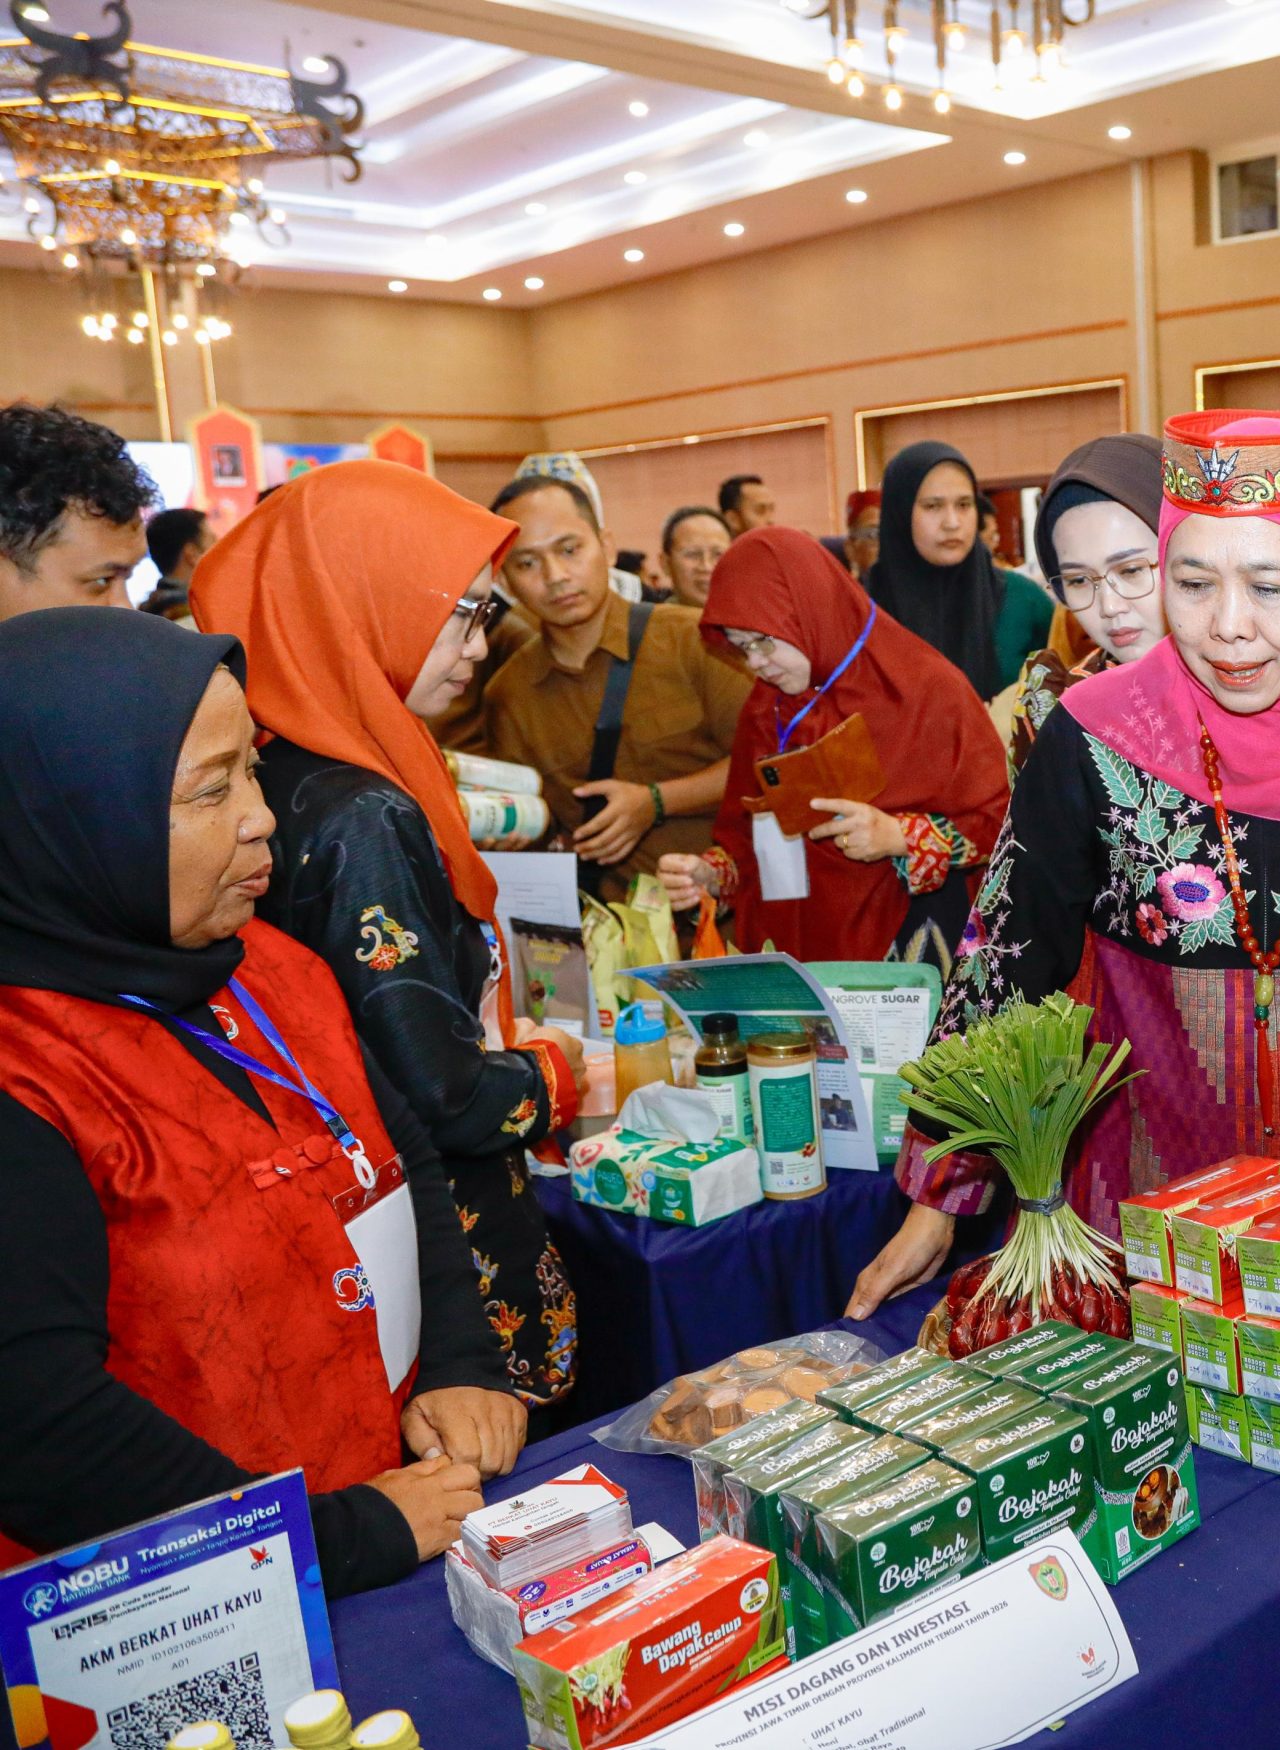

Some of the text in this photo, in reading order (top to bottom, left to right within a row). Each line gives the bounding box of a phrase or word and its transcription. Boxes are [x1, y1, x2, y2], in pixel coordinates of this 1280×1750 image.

[832, 995, 920, 1004] NGROVE SUGAR
[1036, 1341, 1101, 1375] Bajakah
[1083, 1353, 1146, 1391] Bajakah
[1111, 1401, 1178, 1453] Bajakah
[999, 1467, 1082, 1523] Bajakah
[137, 1500, 282, 1562] Transaksi Digital
[140, 1558, 172, 1575] Nyaman
[250, 1557, 274, 1570] GPN
[612, 1543, 635, 1560] HEMAT
[879, 1533, 969, 1593] Bajakah
[57, 1556, 130, 1596] NOBU
[62, 1573, 131, 1604] NATIONAL BANK
[111, 1585, 190, 1620] Pembayaran Nasional
[122, 1597, 142, 1609] Code
[52, 1609, 109, 1640] QRIS
[80, 1588, 263, 1673] AKM BERKAT UHAT KAYU
[640, 1620, 702, 1665] Bawang
[659, 1636, 706, 1674] Dayak
[117, 1659, 144, 1676] NMID
[171, 1657, 190, 1671] A01
[715, 1600, 1009, 1749] PROVINSI JAWA TIMUR DENGAN PROVINSI KALIMANTAN TENGAH TAHUN 2026
[744, 1600, 971, 1723] MISI DAGANG DAN INVESTASI
[811, 1708, 863, 1740] UHAT KAYU
[879, 1707, 927, 1740] Tradisional
[818, 1737, 840, 1749] Heni
